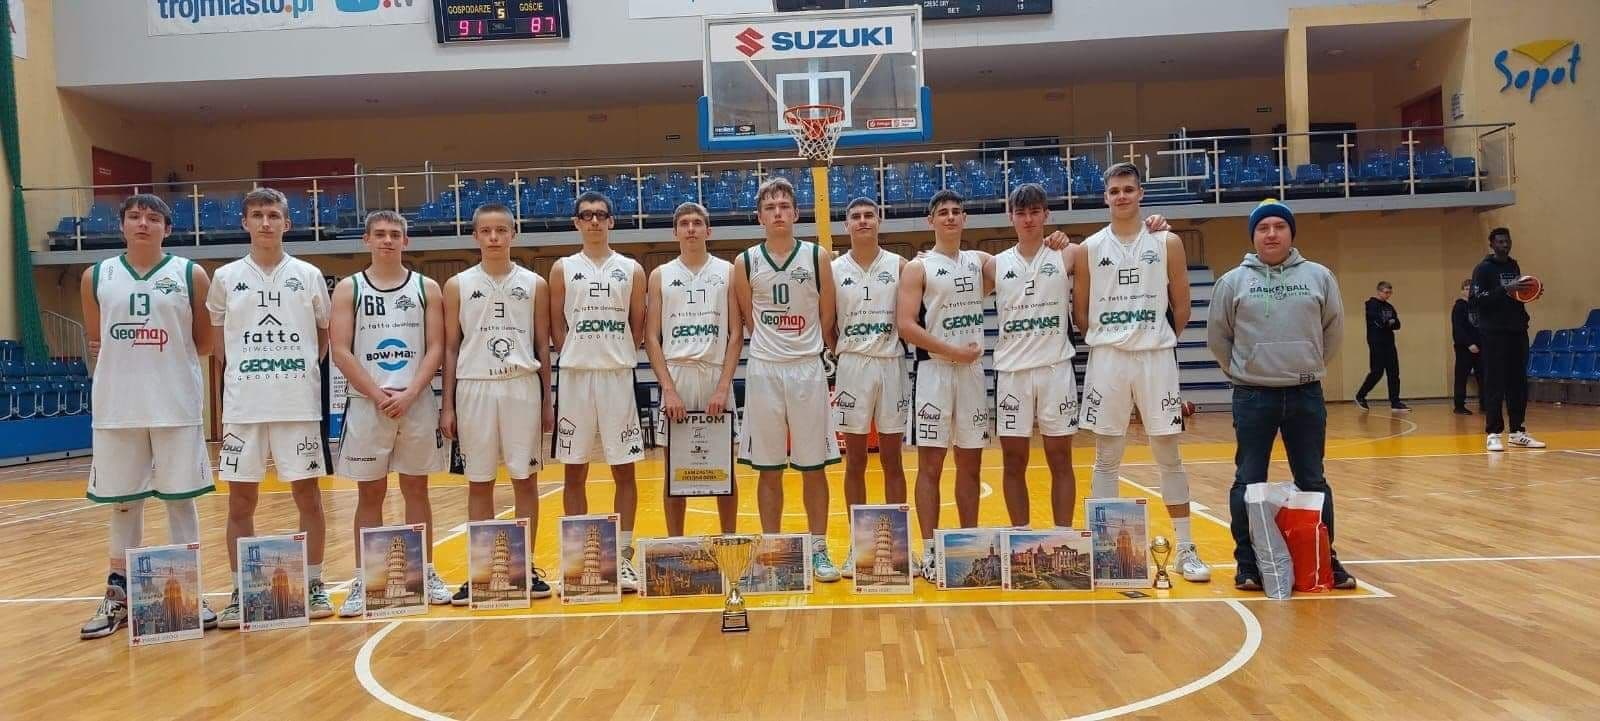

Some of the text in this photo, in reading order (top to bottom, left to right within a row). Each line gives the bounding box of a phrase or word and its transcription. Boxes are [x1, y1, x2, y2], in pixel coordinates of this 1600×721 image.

[448, 5, 492, 14] GOSPODARZE
[519, 2, 544, 12] GOŚCIE
[459, 20, 482, 36] 91
[531, 16, 554, 33] 87
[771, 26, 893, 50] SUZUKI
[1494, 43, 1581, 104] Sopot
[954, 276, 974, 293] 55
[1118, 268, 1139, 285] 66
[589, 282, 610, 297] 24
[686, 289, 706, 304] 17
[772, 283, 789, 305] 10
[863, 286, 872, 300] 1
[1025, 280, 1035, 296] 2
[1249, 283, 1311, 294] BASKETBALL
[129, 292, 150, 316] 13
[257, 290, 280, 307] 14
[364, 295, 386, 316] 68
[494, 302, 504, 318] 3
[761, 306, 806, 336] Geomap
[942, 313, 984, 330] GEOMA
[110, 318, 169, 352] Geomap
[243, 330, 300, 344] fatto
[839, 412, 849, 426] 1
[1005, 414, 1016, 430] 2
[919, 423, 938, 440] 55
